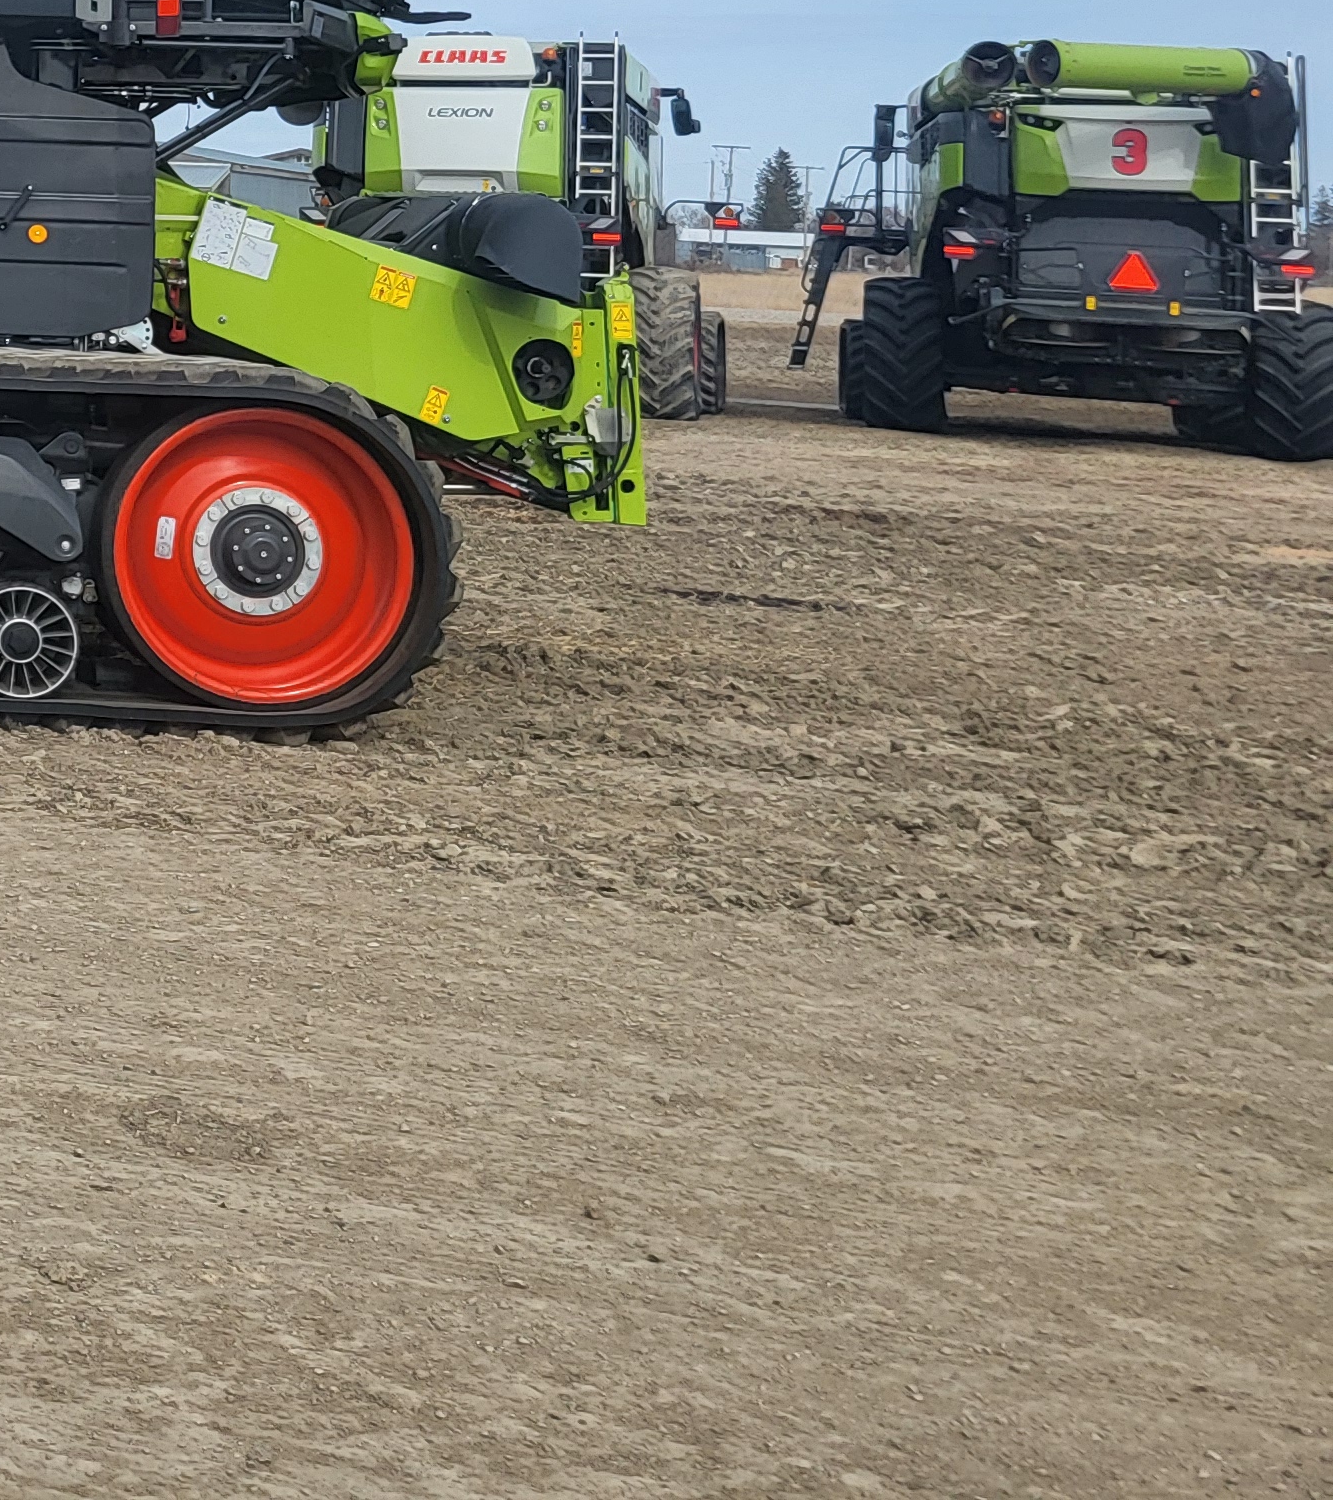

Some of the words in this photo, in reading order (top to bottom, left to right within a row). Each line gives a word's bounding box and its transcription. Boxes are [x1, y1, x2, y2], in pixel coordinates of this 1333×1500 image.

[417, 50, 508, 64] CLAAS
[427, 107, 494, 118] LEXION
[1111, 128, 1148, 176] 3
